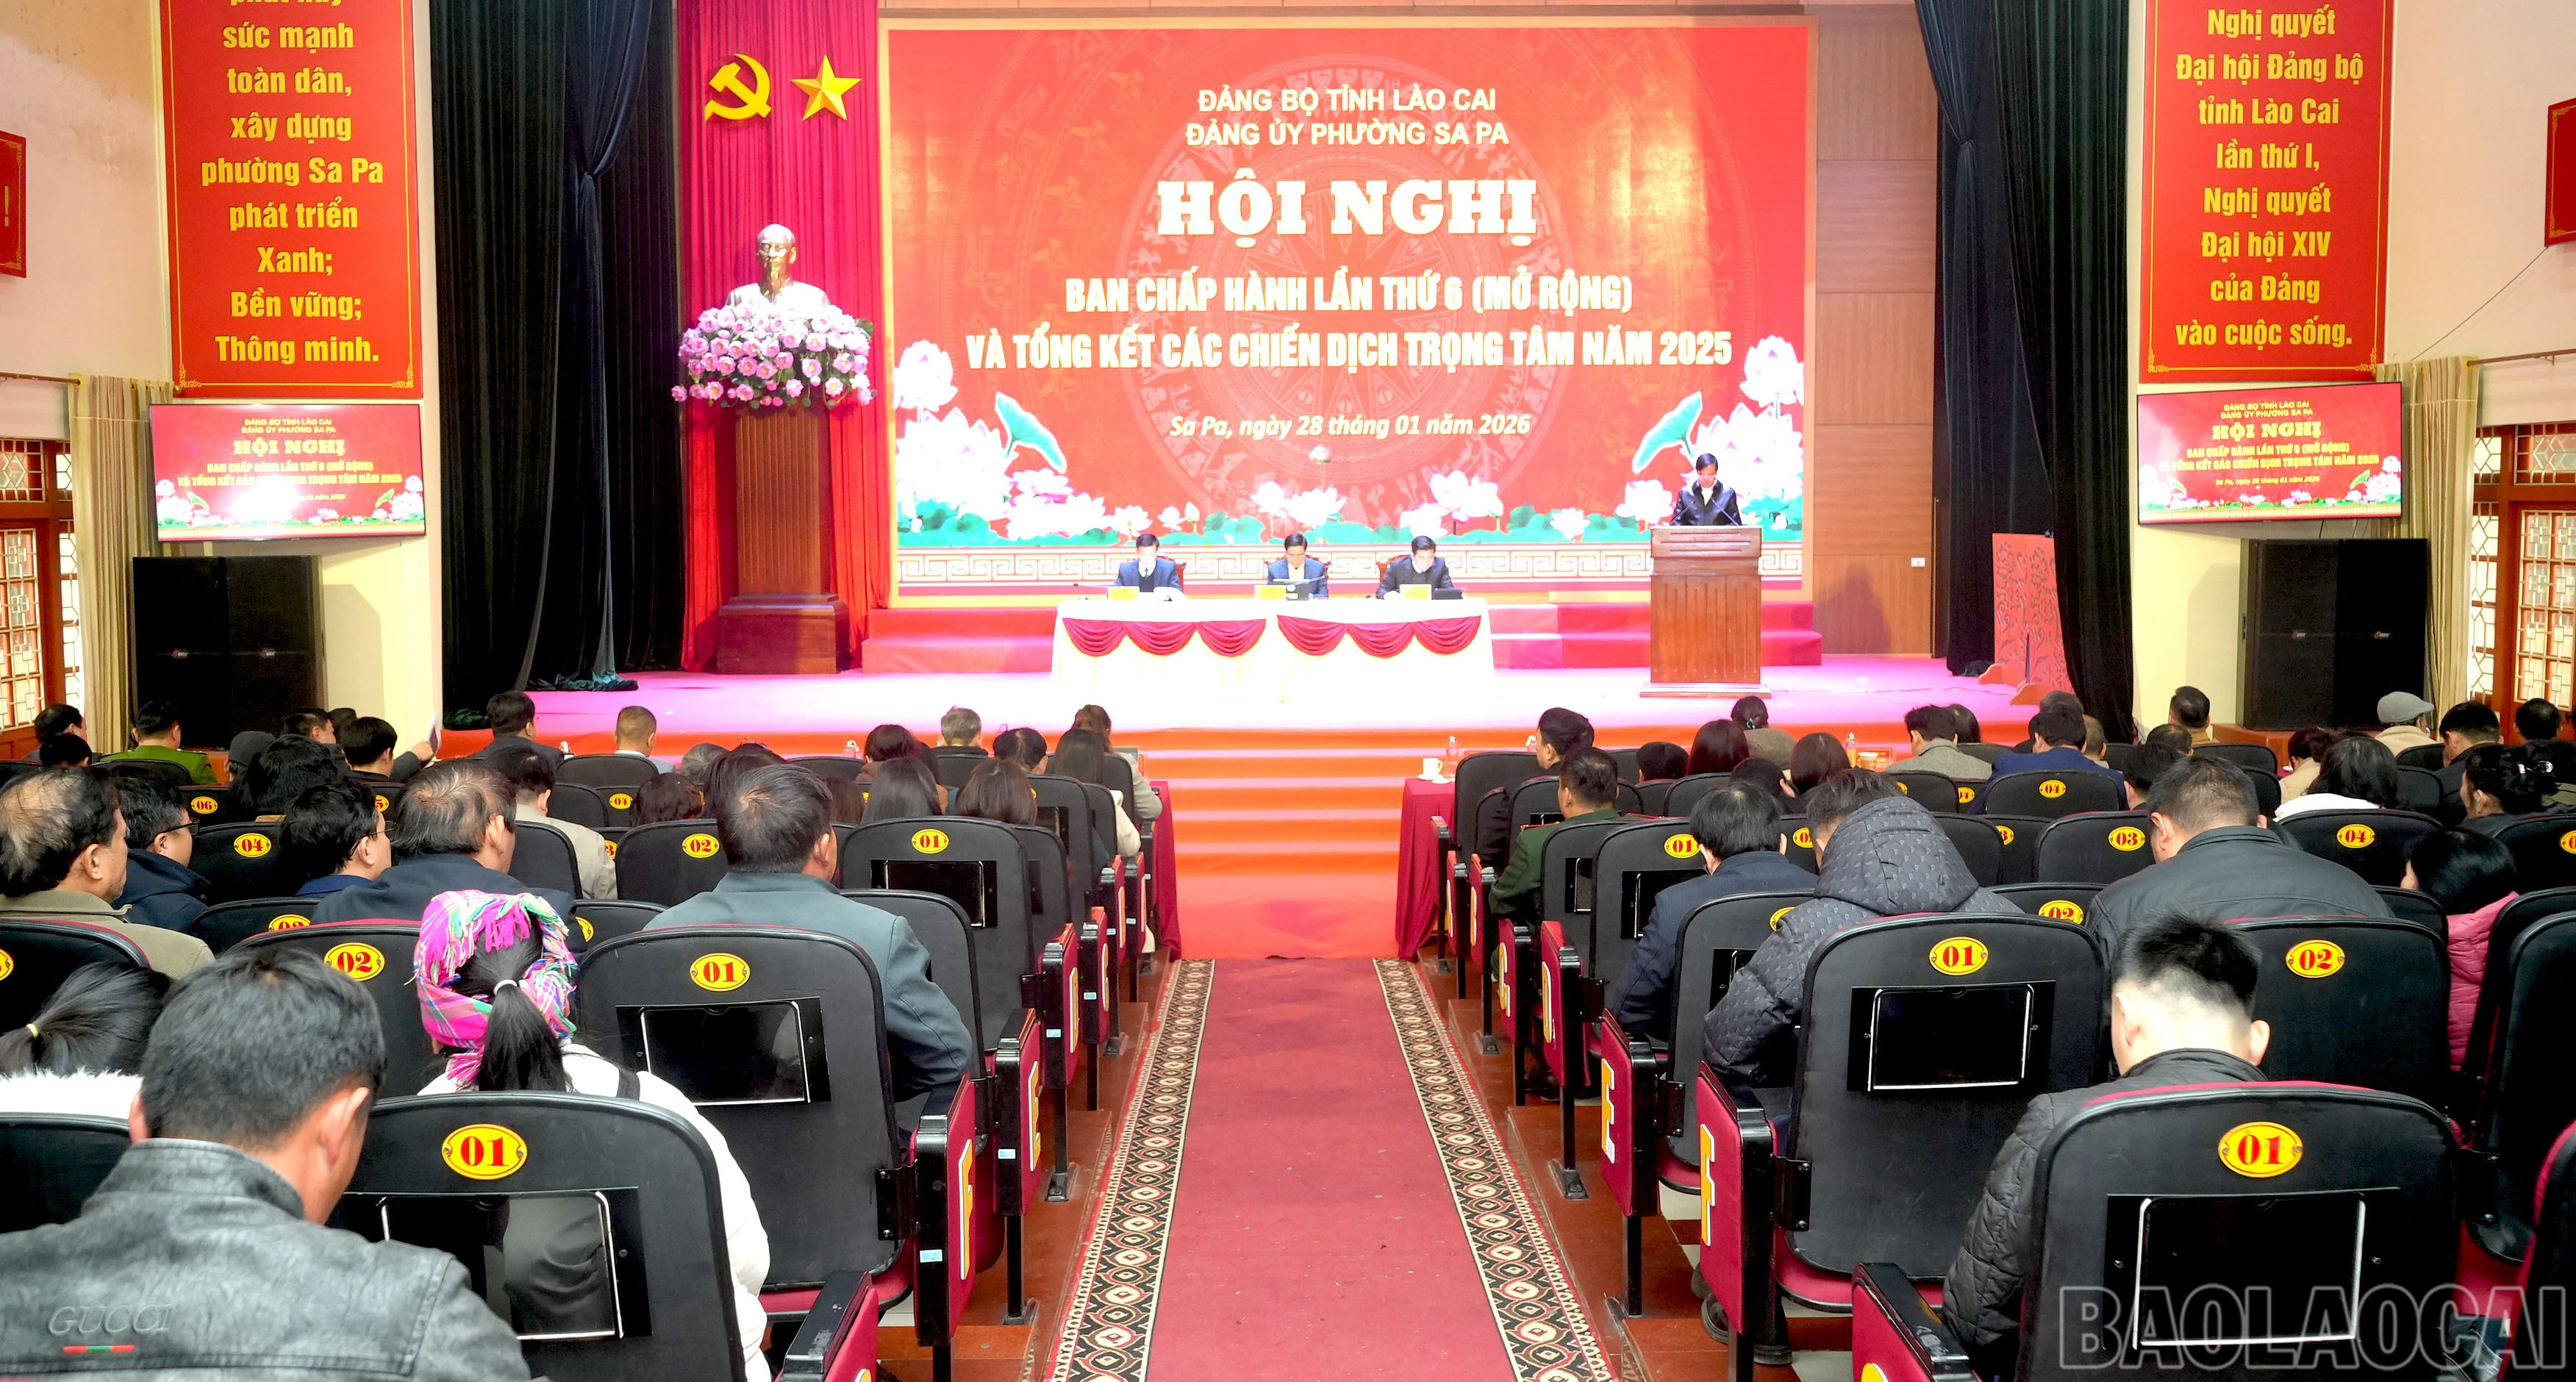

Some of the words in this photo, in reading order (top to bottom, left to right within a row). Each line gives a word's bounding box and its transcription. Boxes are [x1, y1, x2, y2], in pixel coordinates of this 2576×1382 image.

[2208, 10, 2261, 40] Nghị
[2271, 4, 2335, 37] quyết
[223, 22, 270, 48] sức
[280, 23, 354, 54] mạnh
[227, 67, 285, 93] toàn
[296, 67, 351, 96] dân,
[2176, 54, 2214, 85] Đại
[2223, 54, 2259, 85] hội
[2267, 51, 2327, 82] Đảng
[2336, 53, 2363, 84] bộ
[1198, 85, 1272, 111] ĐẢNG
[1281, 87, 1318, 116] BỘ
[1325, 84, 1384, 111] TỈNH
[1393, 84, 1445, 110] LÀO
[1453, 89, 1495, 110] CAI
[2198, 95, 2243, 124] tỉnh
[2252, 98, 2292, 123] Lào
[2302, 99, 2339, 123] Cai
[232, 112, 277, 141] xây
[287, 113, 351, 143] dựng
[1186, 118, 1259, 146] ĐẢNG
[1270, 118, 1304, 145] ỦY
[1312, 118, 1425, 145] PHƯỜNG
[1434, 122, 1470, 144] SA
[1476, 122, 1509, 144] PA
[2217, 138, 2253, 168] lần
[2261, 143, 2299, 168] thứ
[2305, 143, 2319, 171] I,
[202, 157, 299, 186] phường
[309, 157, 342, 183] Sa
[351, 157, 383, 183] Pa
[230, 202, 288, 231] phát
[296, 196, 357, 228] triển
[1158, 168, 1306, 248] HỘI
[1331, 179, 1536, 246] NGHỊ
[2204, 187, 2258, 218] Nghị
[2266, 182, 2330, 215] quyết
[2201, 232, 2239, 262] Đại
[2248, 231, 2283, 262] hội
[2292, 232, 2330, 256] XIV
[258, 247, 332, 276] Xanh;
[1066, 278, 1128, 312] BAN
[1137, 266, 1217, 312] CHẤP
[1224, 271, 1306, 311] HÀNH
[1314, 265, 1372, 310] LẦN
[1380, 269, 1440, 310] THỨ
[1445, 276, 1462, 310] 6
[1473, 265, 1532, 313] (MỞ
[1539, 269, 1632, 316] RỘNG)
[2211, 276, 2253, 301] của
[2261, 273, 2319, 304] Đảng
[232, 286, 281, 317] Bền
[290, 292, 361, 321] vững;
[966, 329, 1006, 368] VÀ
[1013, 321, 1091, 368] TỔNG
[1100, 323, 1155, 368] KẾT
[1162, 326, 1222, 368] CÁC
[1229, 323, 1320, 367] CHIẾN
[1328, 332, 1398, 373] DỊCH
[1404, 332, 1503, 373] TRỌNG
[1510, 325, 1574, 365] TÂM
[1583, 324, 1652, 365] NĂM
[1659, 331, 1731, 365] 2025
[2176, 319, 2217, 345] vào
[2225, 319, 2281, 350] cuộc
[2290, 315, 2352, 347] sống.
[215, 335, 295, 365] Thông
[305, 337, 379, 362] minh.
[1170, 416, 1196, 436] Sa
[1201, 416, 1233, 439] Pa,
[1239, 415, 1292, 440] ngày
[1296, 415, 1323, 435] 28
[1328, 414, 1389, 439] tháng
[1395, 415, 1420, 434] 01
[1426, 413, 1473, 434] năm
[1478, 414, 1531, 434] 2026
[2213, 422, 2255, 441] HỘI
[2261, 421, 2321, 438] NGHỊ
[234, 437, 279, 457] HỘI
[285, 439, 345, 457] NGHỊ
[2044, 784, 2061, 794] 04
[197, 801, 212, 810] 06
[376, 799, 384, 809] 5
[242, 839, 264, 852] 04
[690, 839, 712, 852] 02
[920, 836, 941, 848] 01
[1672, 840, 1694, 853] 01
[2116, 833, 2138, 845] 03
[2344, 831, 2366, 843] 04
[337, 951, 373, 972] 02
[1943, 946, 1975, 967] 01
[2299, 949, 2332, 970] 02
[704, 962, 736, 983] 01
[460, 1136, 507, 1167] 01
[2237, 1135, 2283, 1165] 01
[1700, 1123, 1715, 1247] F
[48, 1304, 175, 1336] GUCCI
